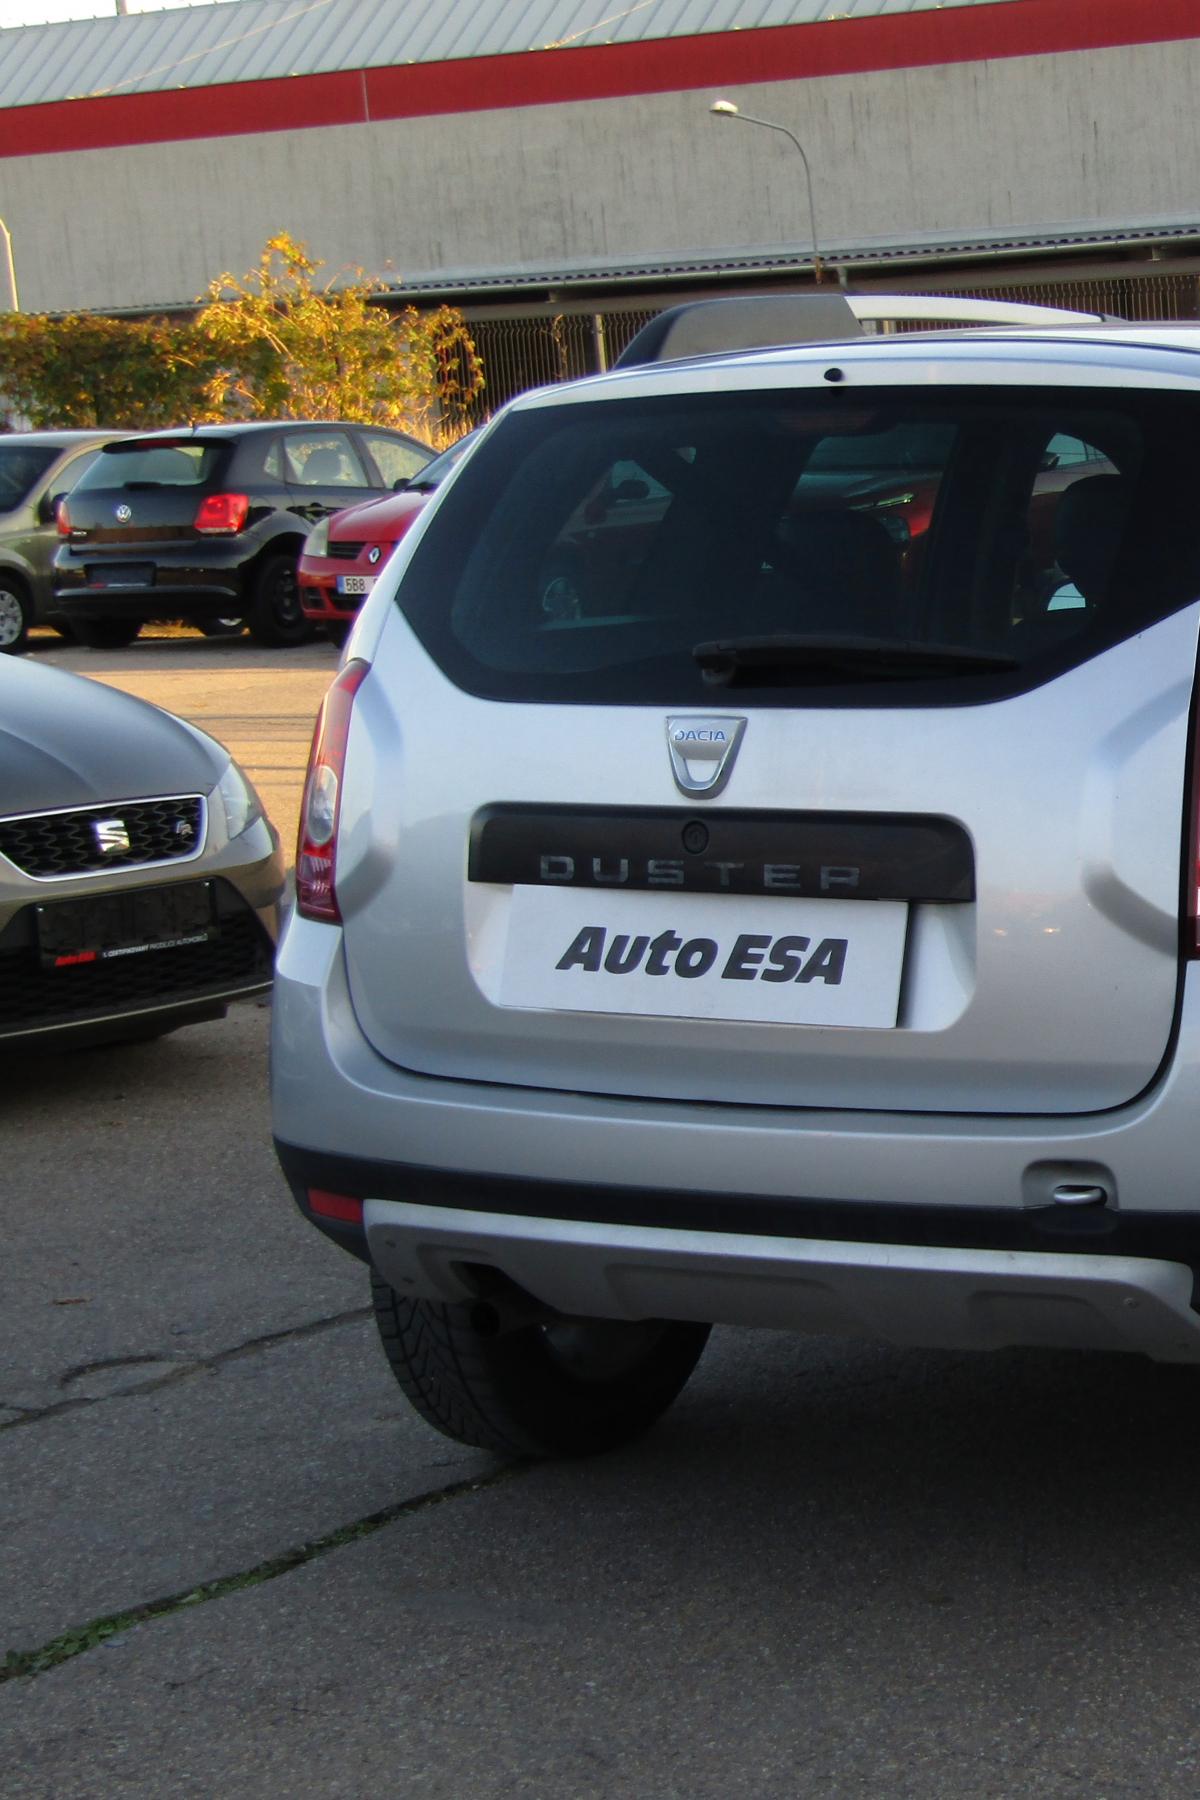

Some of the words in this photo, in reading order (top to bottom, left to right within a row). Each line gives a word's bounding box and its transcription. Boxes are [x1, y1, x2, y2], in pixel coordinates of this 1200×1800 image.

[675, 730, 726, 741] DACIA
[540, 855, 860, 890] DUSTER
[555, 926, 719, 979] Auto
[721, 934, 849, 985] ESA
